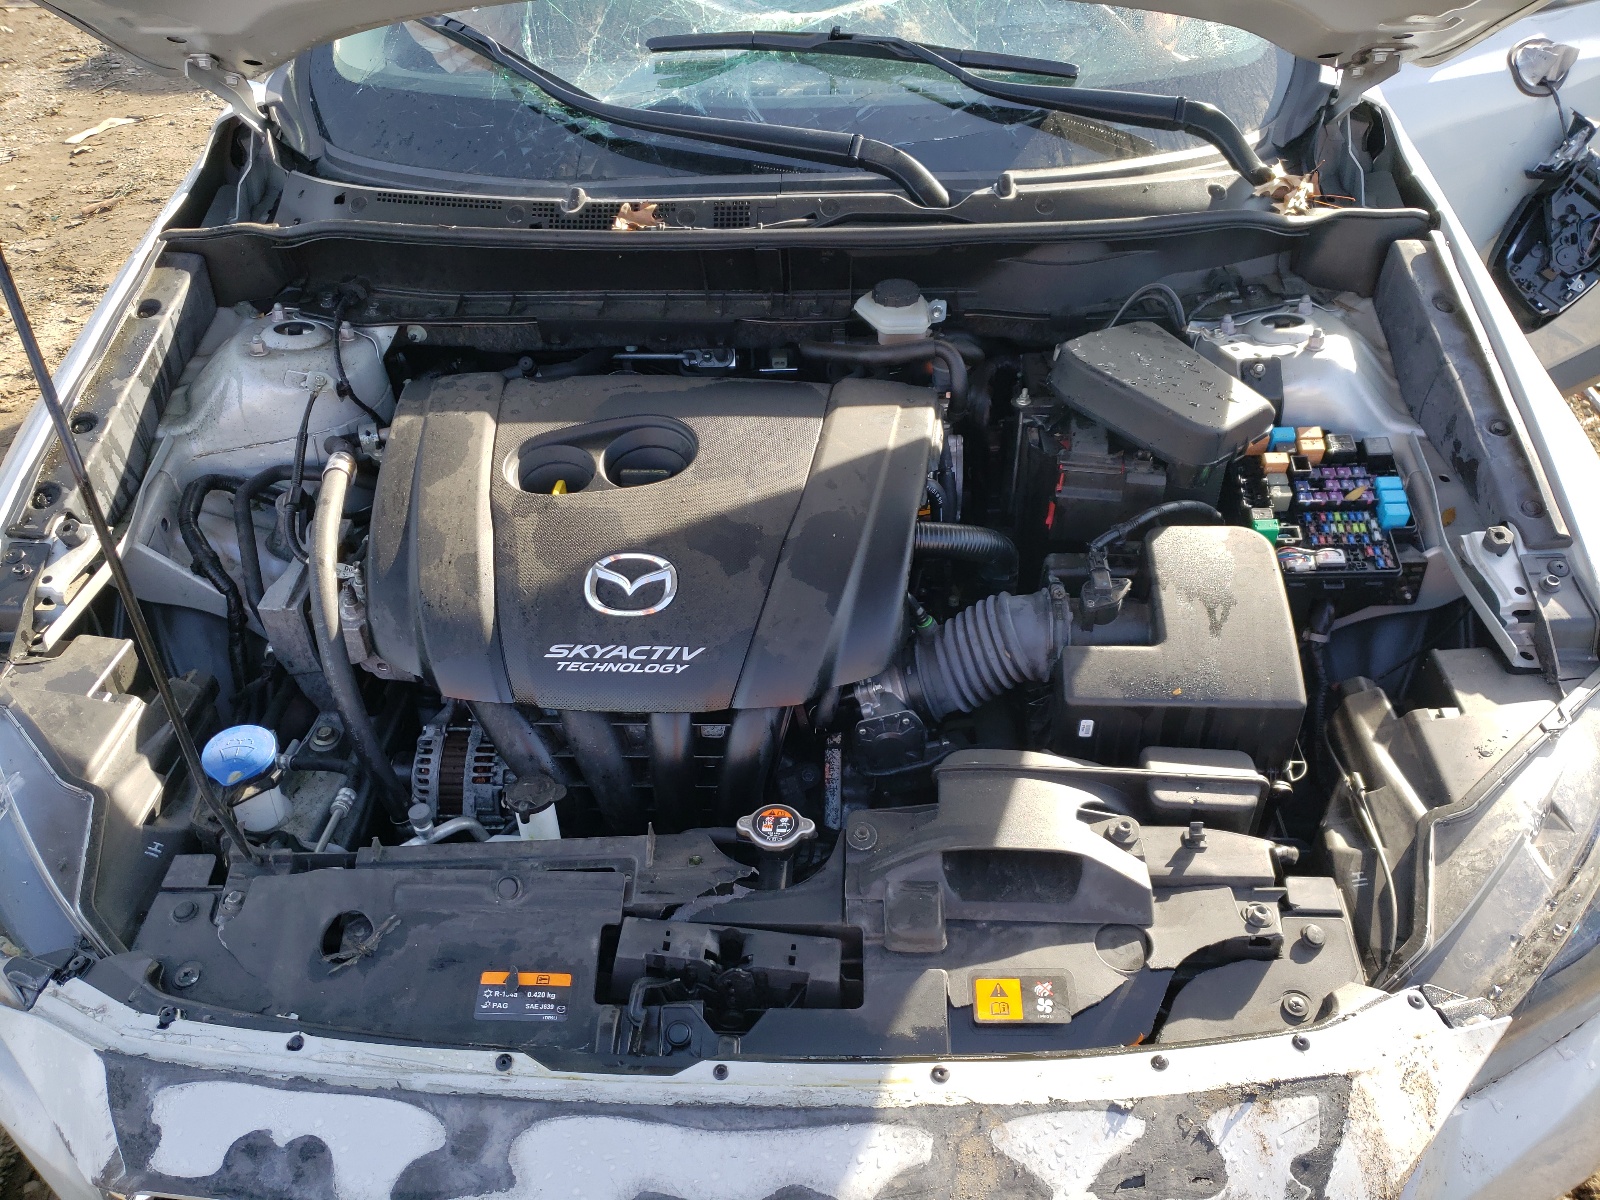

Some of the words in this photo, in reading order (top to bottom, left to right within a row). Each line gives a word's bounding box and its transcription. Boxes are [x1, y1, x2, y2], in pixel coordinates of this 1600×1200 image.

[543, 643, 707, 661] SKYACTIV
[556, 661, 690, 674] TECHNOLOGY
[546, 991, 556, 999] kg
